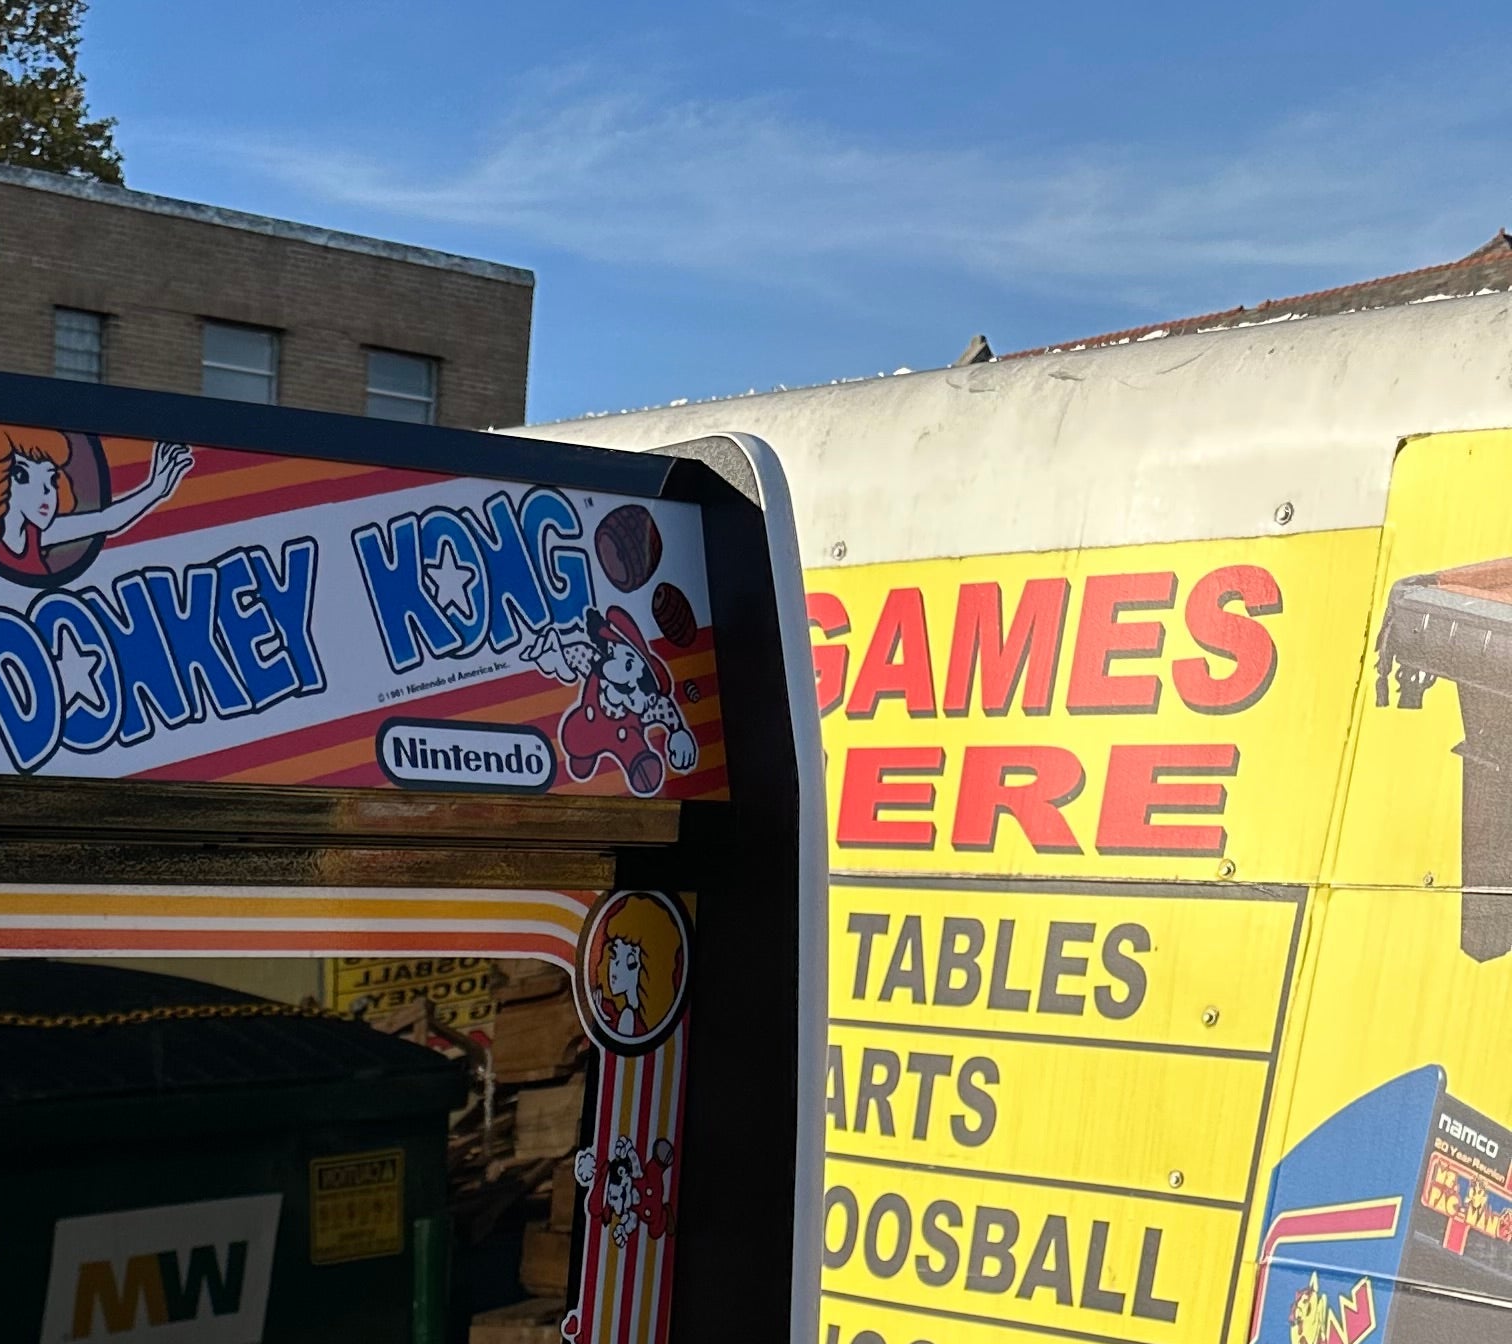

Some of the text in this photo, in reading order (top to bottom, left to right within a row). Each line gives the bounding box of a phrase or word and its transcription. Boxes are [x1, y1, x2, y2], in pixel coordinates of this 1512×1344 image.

[352, 485, 596, 675] KONG
[406, 676, 447, 694] Nintendo
[457, 665, 494, 682] America
[392, 736, 544, 775] Nintendo
[825, 743, 1241, 856] ERE
[846, 911, 1152, 1021] TABLES
[1439, 1112, 1499, 1160] namco
[1434, 1137, 1506, 1186] 20 Year Reunion
